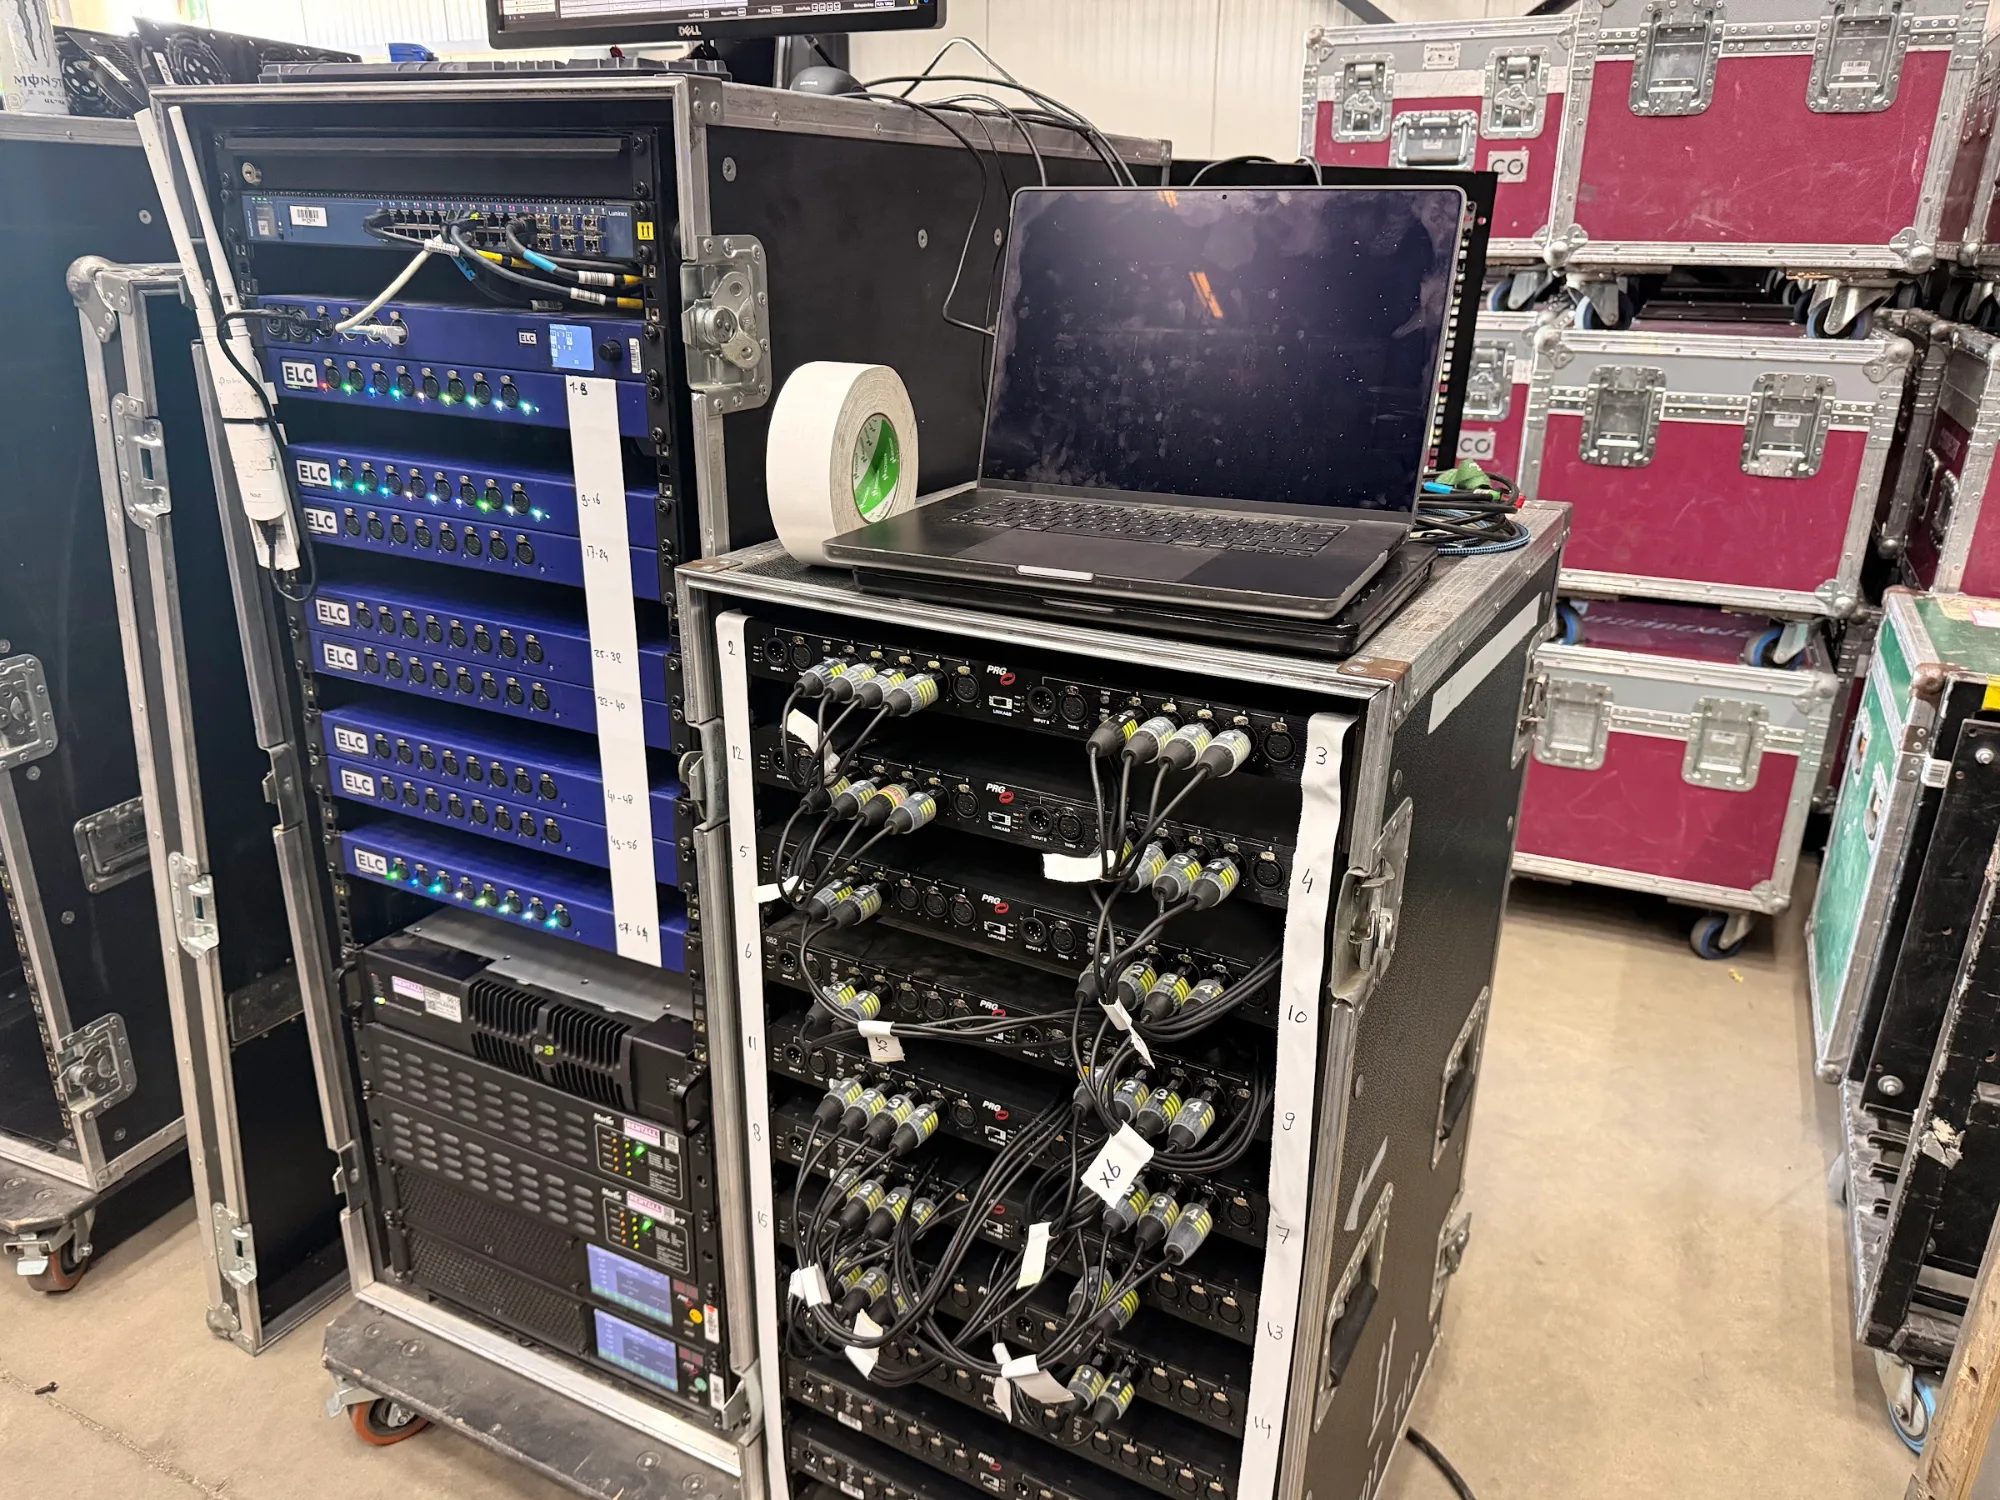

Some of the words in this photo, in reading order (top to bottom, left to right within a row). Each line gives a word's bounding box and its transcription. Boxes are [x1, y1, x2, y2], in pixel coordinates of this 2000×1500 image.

[678, 26, 701, 36] DELL
[1491, 158, 1524, 175] CO
[520, 334, 535, 343] ELC
[285, 366, 314, 384] ELC
[1460, 437, 1491, 454] CO
[300, 465, 327, 482] ELC
[306, 512, 333, 529] ELC
[319, 604, 346, 621] ELC
[728, 640, 736, 656] 2
[327, 648, 354, 665] ELC
[986, 664, 1007, 676] PRG
[337, 732, 364, 749] ELC
[732, 745, 744, 760] 12
[1316, 746, 1328, 765] 3
[344, 775, 370, 792] ELC
[985, 782, 1006, 793] PRG
[740, 845, 750, 858] 5
[357, 853, 384, 871] ELC
[1174, 855, 1189, 865] 3
[1207, 861, 1222, 870] 4
[833, 880, 843, 889] 1
[1301, 868, 1313, 894] 4
[858, 886, 873, 896] 2
[981, 893, 1001, 905] PRG
[744, 943, 752, 959] 6
[1130, 964, 1145, 977] 2
[1163, 973, 1177, 984] 3
[832, 982, 847, 991] 3
[1199, 984, 1213, 994] 4
[979, 999, 999, 1011] PRG
[1288, 1004, 1307, 1023] 10
[748, 1035, 757, 1051] 11
[839, 1080, 851, 1089] 1
[1121, 1080, 1136, 1093] 2
[862, 1090, 876, 1102] 2
[1154, 1088, 1168, 1100] 3
[887, 1096, 902, 1108] 3
[982, 1099, 1001, 1112] PRG
[1188, 1101, 1202, 1113] 4
[914, 1107, 929, 1117] 4
[1282, 1112, 1295, 1130] 9
[752, 1122, 762, 1142] 8
[838, 1173, 850, 1184] 1
[860, 1184, 873, 1196] 2
[887, 1193, 900, 1205] 3
[1153, 1196, 1168, 1208] 3
[913, 1202, 925, 1214] 4
[1185, 1208, 1200, 1221] 4
[757, 1210, 769, 1229] 15
[1275, 1224, 1290, 1244] 7
[864, 1271, 877, 1284] 2
[1266, 1321, 1284, 1340] 13
[1081, 1369, 1091, 1380] 3
[1111, 1380, 1121, 1389] 4
[1254, 1415, 1273, 1440] 14
[978, 1451, 996, 1464] PRG
